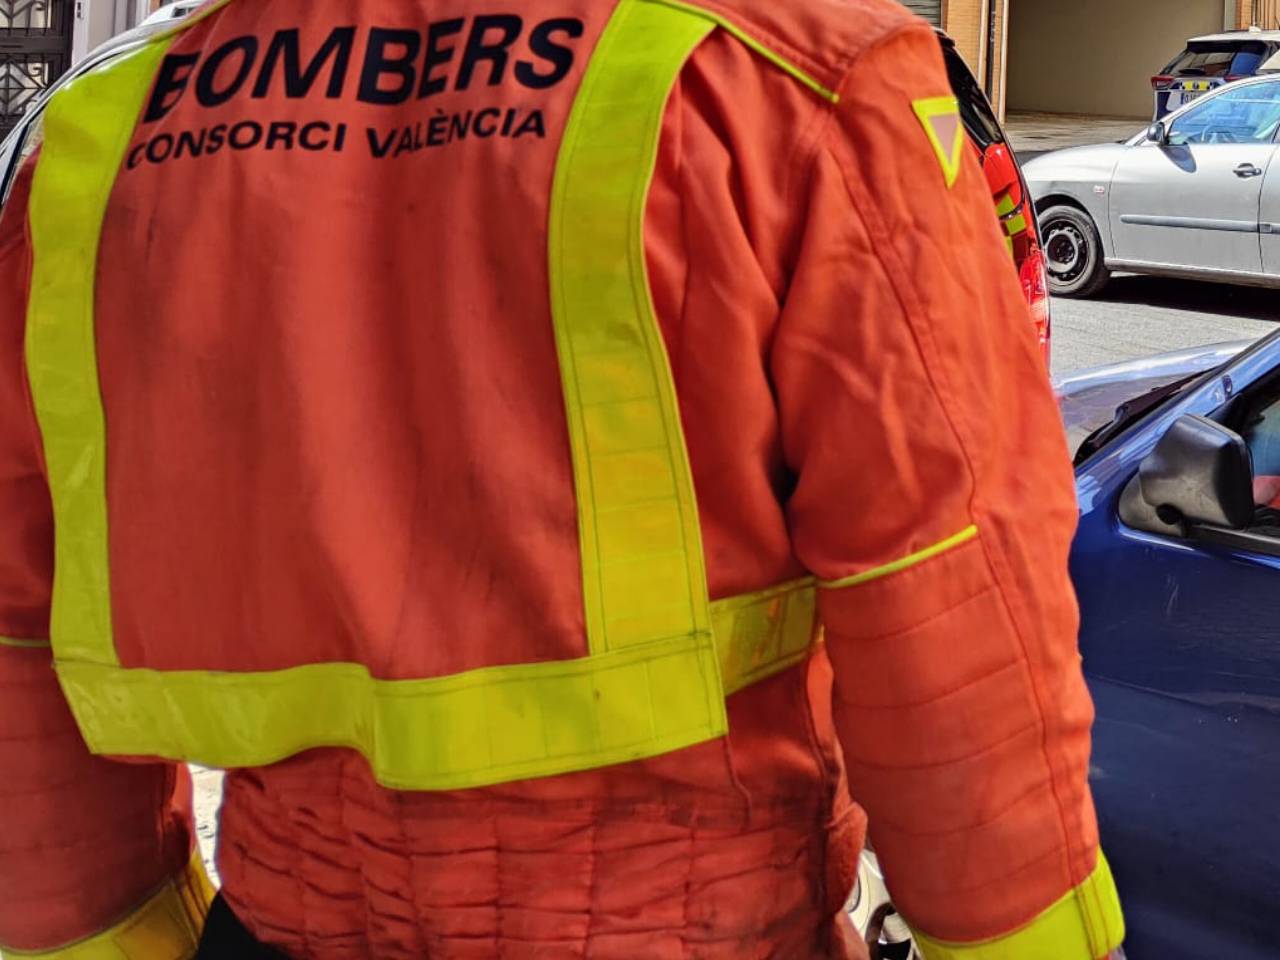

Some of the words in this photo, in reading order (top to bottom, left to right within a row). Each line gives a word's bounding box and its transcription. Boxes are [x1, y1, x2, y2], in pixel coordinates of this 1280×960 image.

[142, 13, 585, 124] BOMBERS
[125, 121, 347, 171] CONSORCI
[366, 107, 547, 159] VALÈNCIA
